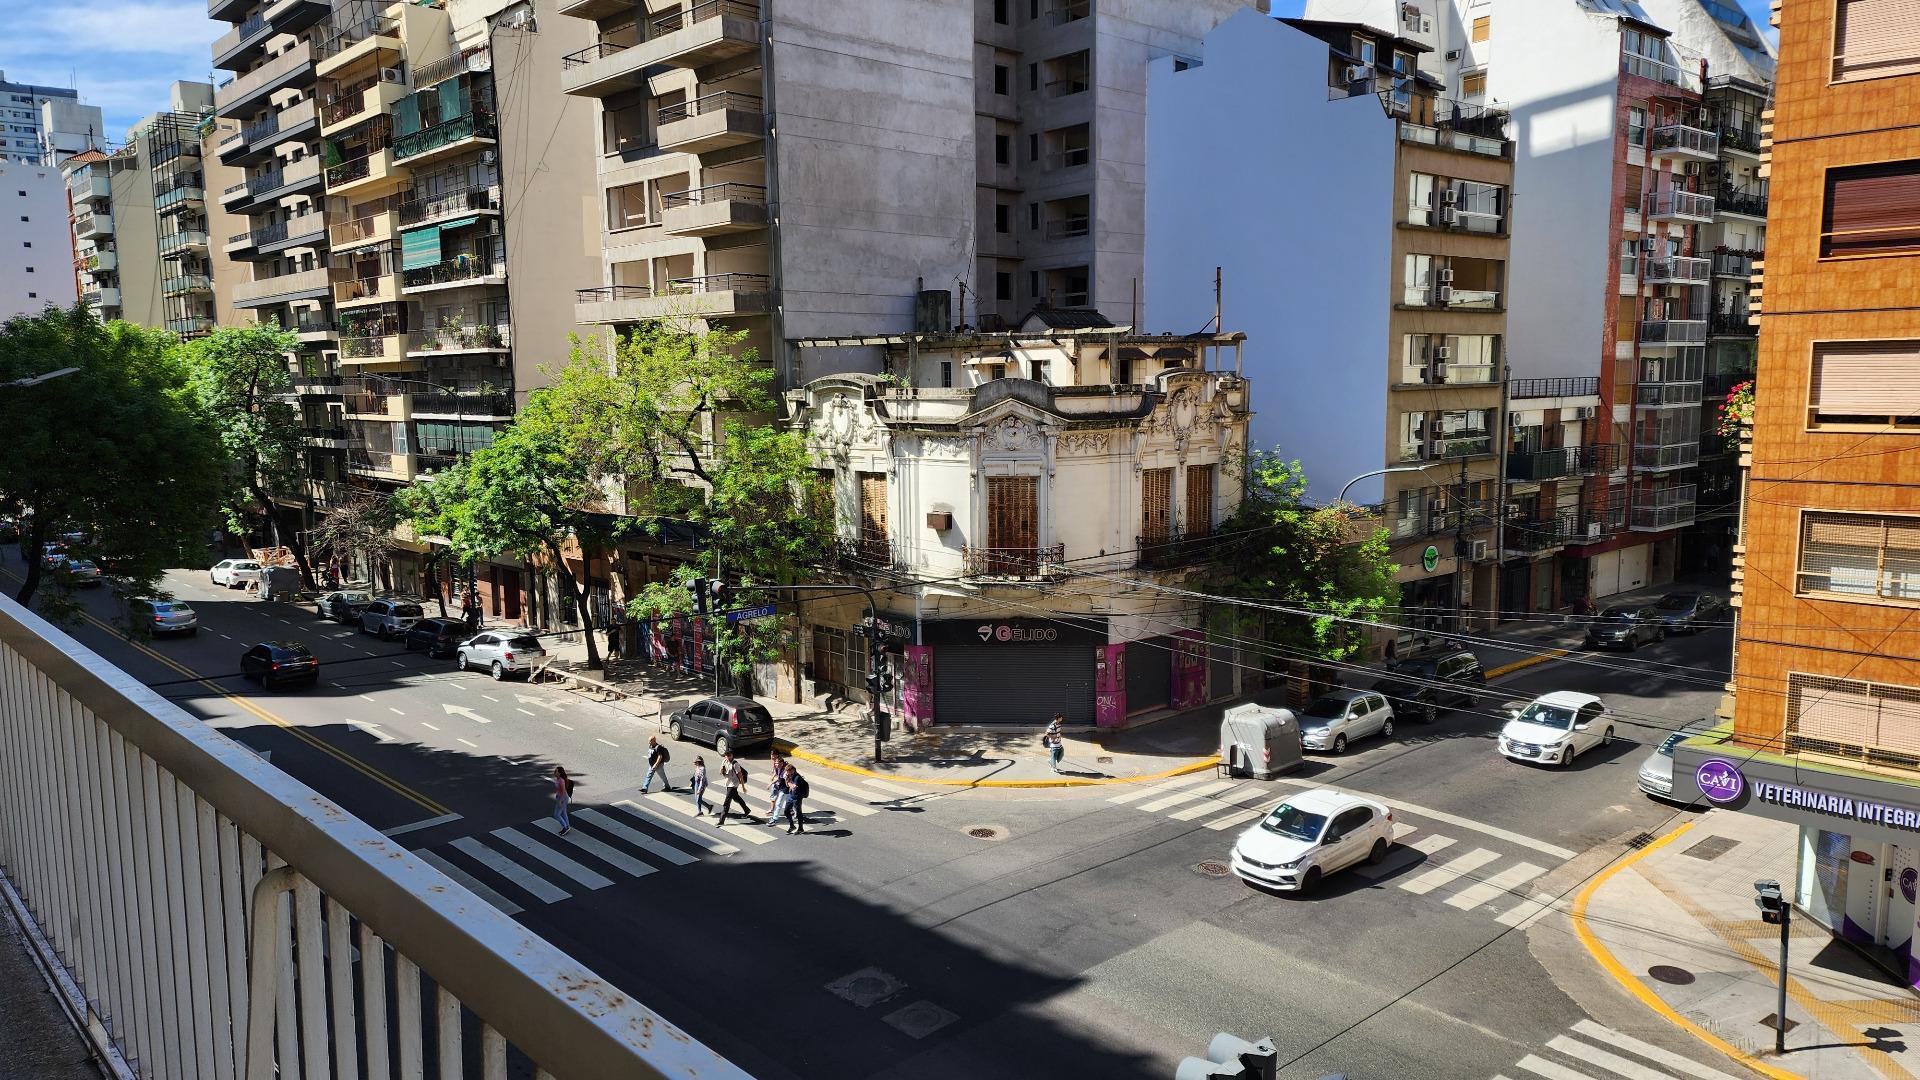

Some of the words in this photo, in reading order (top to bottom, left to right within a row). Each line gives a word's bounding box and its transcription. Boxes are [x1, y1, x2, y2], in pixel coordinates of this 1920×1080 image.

[737, 608, 768, 620] AGRELO
[996, 624, 1058, 641] GÉLIDO
[1700, 772, 1737, 790] CAVI
[1755, 782, 1853, 816] VETERINARIA
